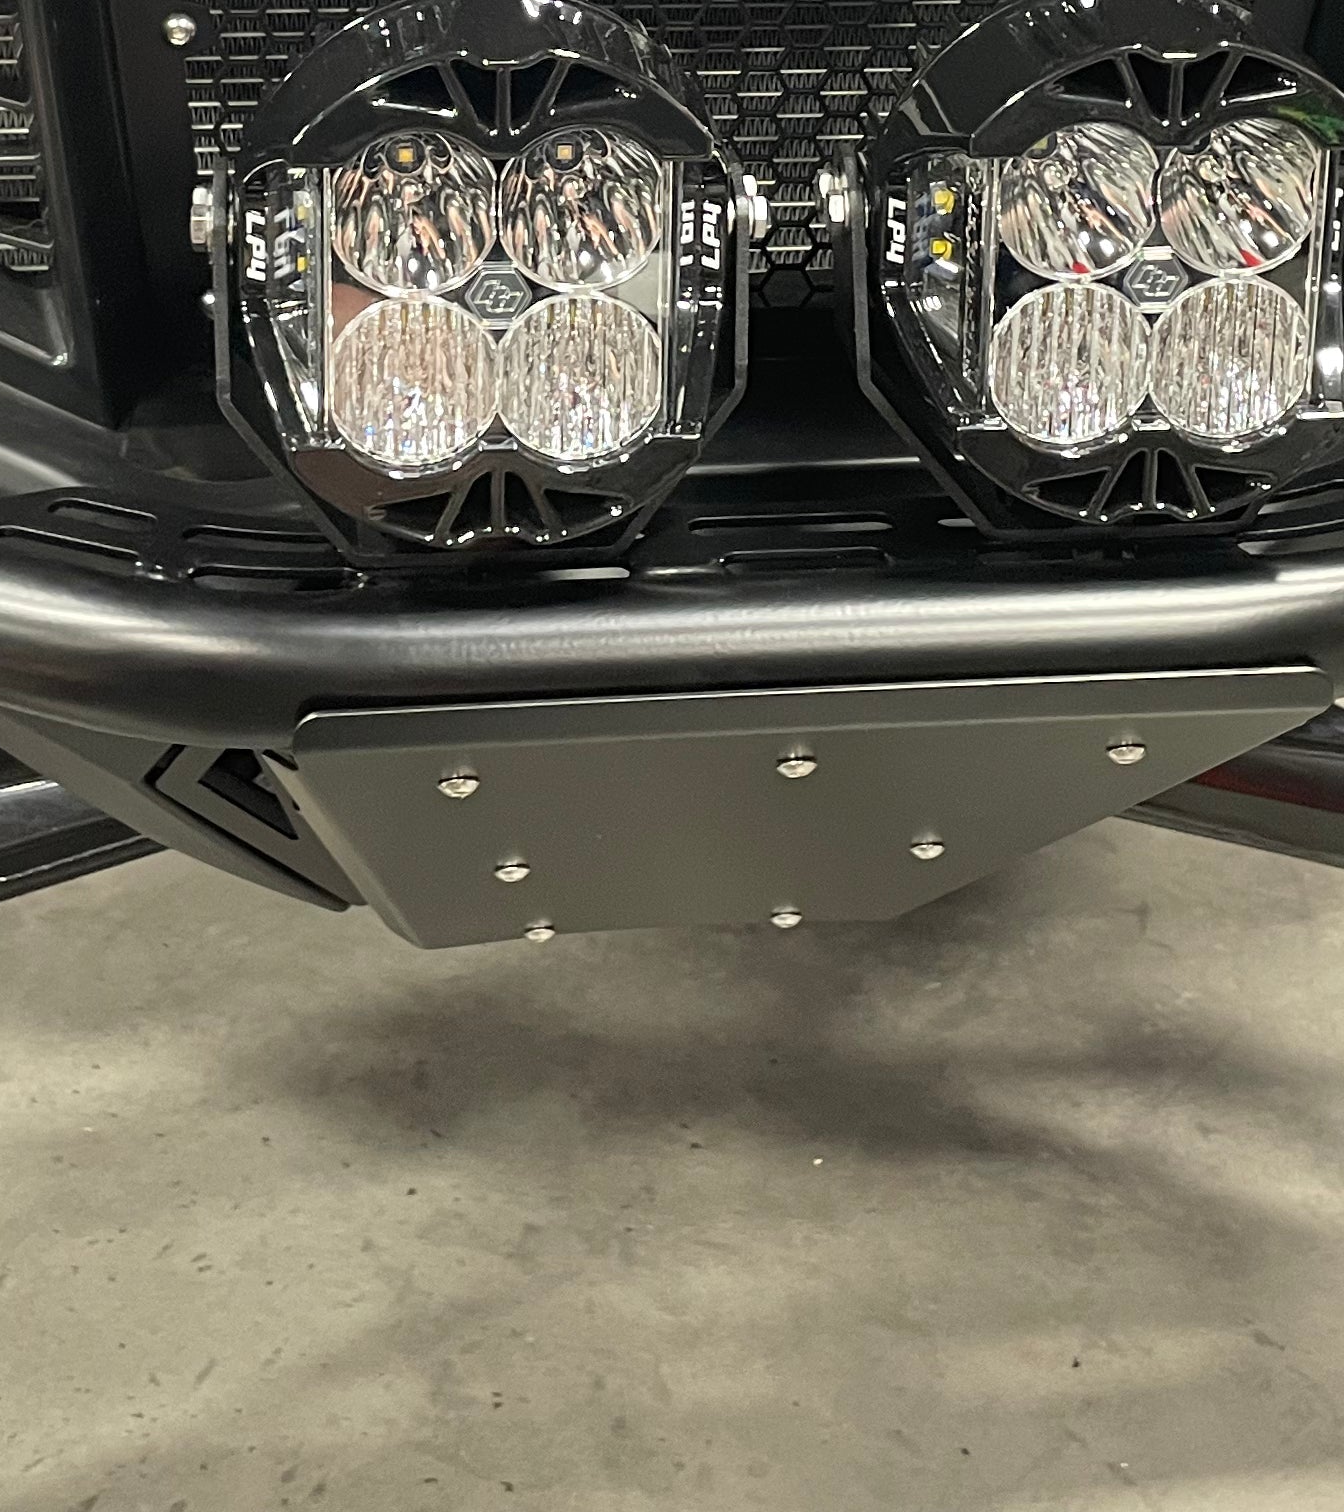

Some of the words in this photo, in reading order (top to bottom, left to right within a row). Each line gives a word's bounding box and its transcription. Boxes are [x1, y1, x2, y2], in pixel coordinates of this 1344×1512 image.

[244, 209, 267, 283] LP4
[701, 200, 723, 271] LP4
[886, 196, 907, 265] LP4
